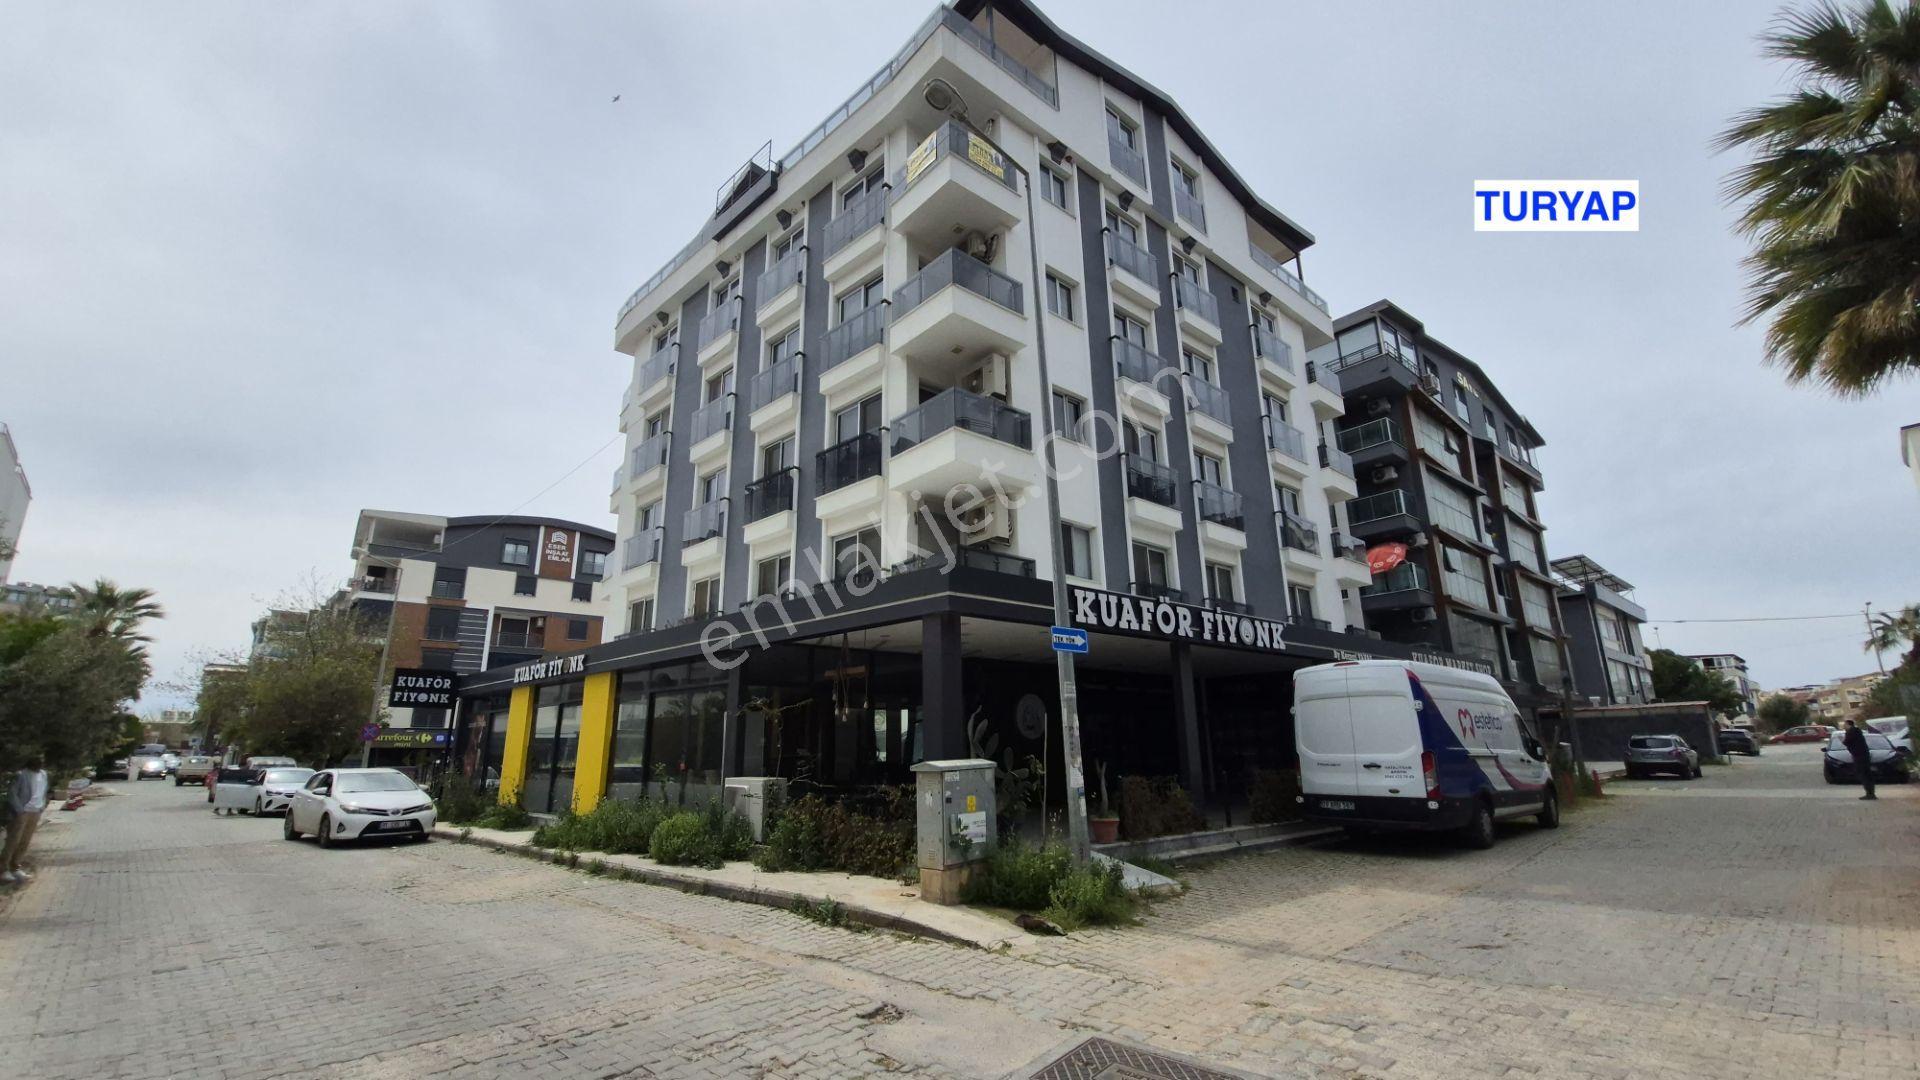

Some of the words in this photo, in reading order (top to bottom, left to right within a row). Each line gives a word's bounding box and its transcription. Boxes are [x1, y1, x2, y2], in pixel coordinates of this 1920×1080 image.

[1074, 588, 1194, 638] KUAFÖR
[1201, 606, 1287, 650] FİYONK
[513, 659, 547, 683] KUAFÖR
[396, 675, 451, 689] KUAFÖR
[393, 689, 450, 703] FİYONK
[375, 733, 413, 741] arrefour
